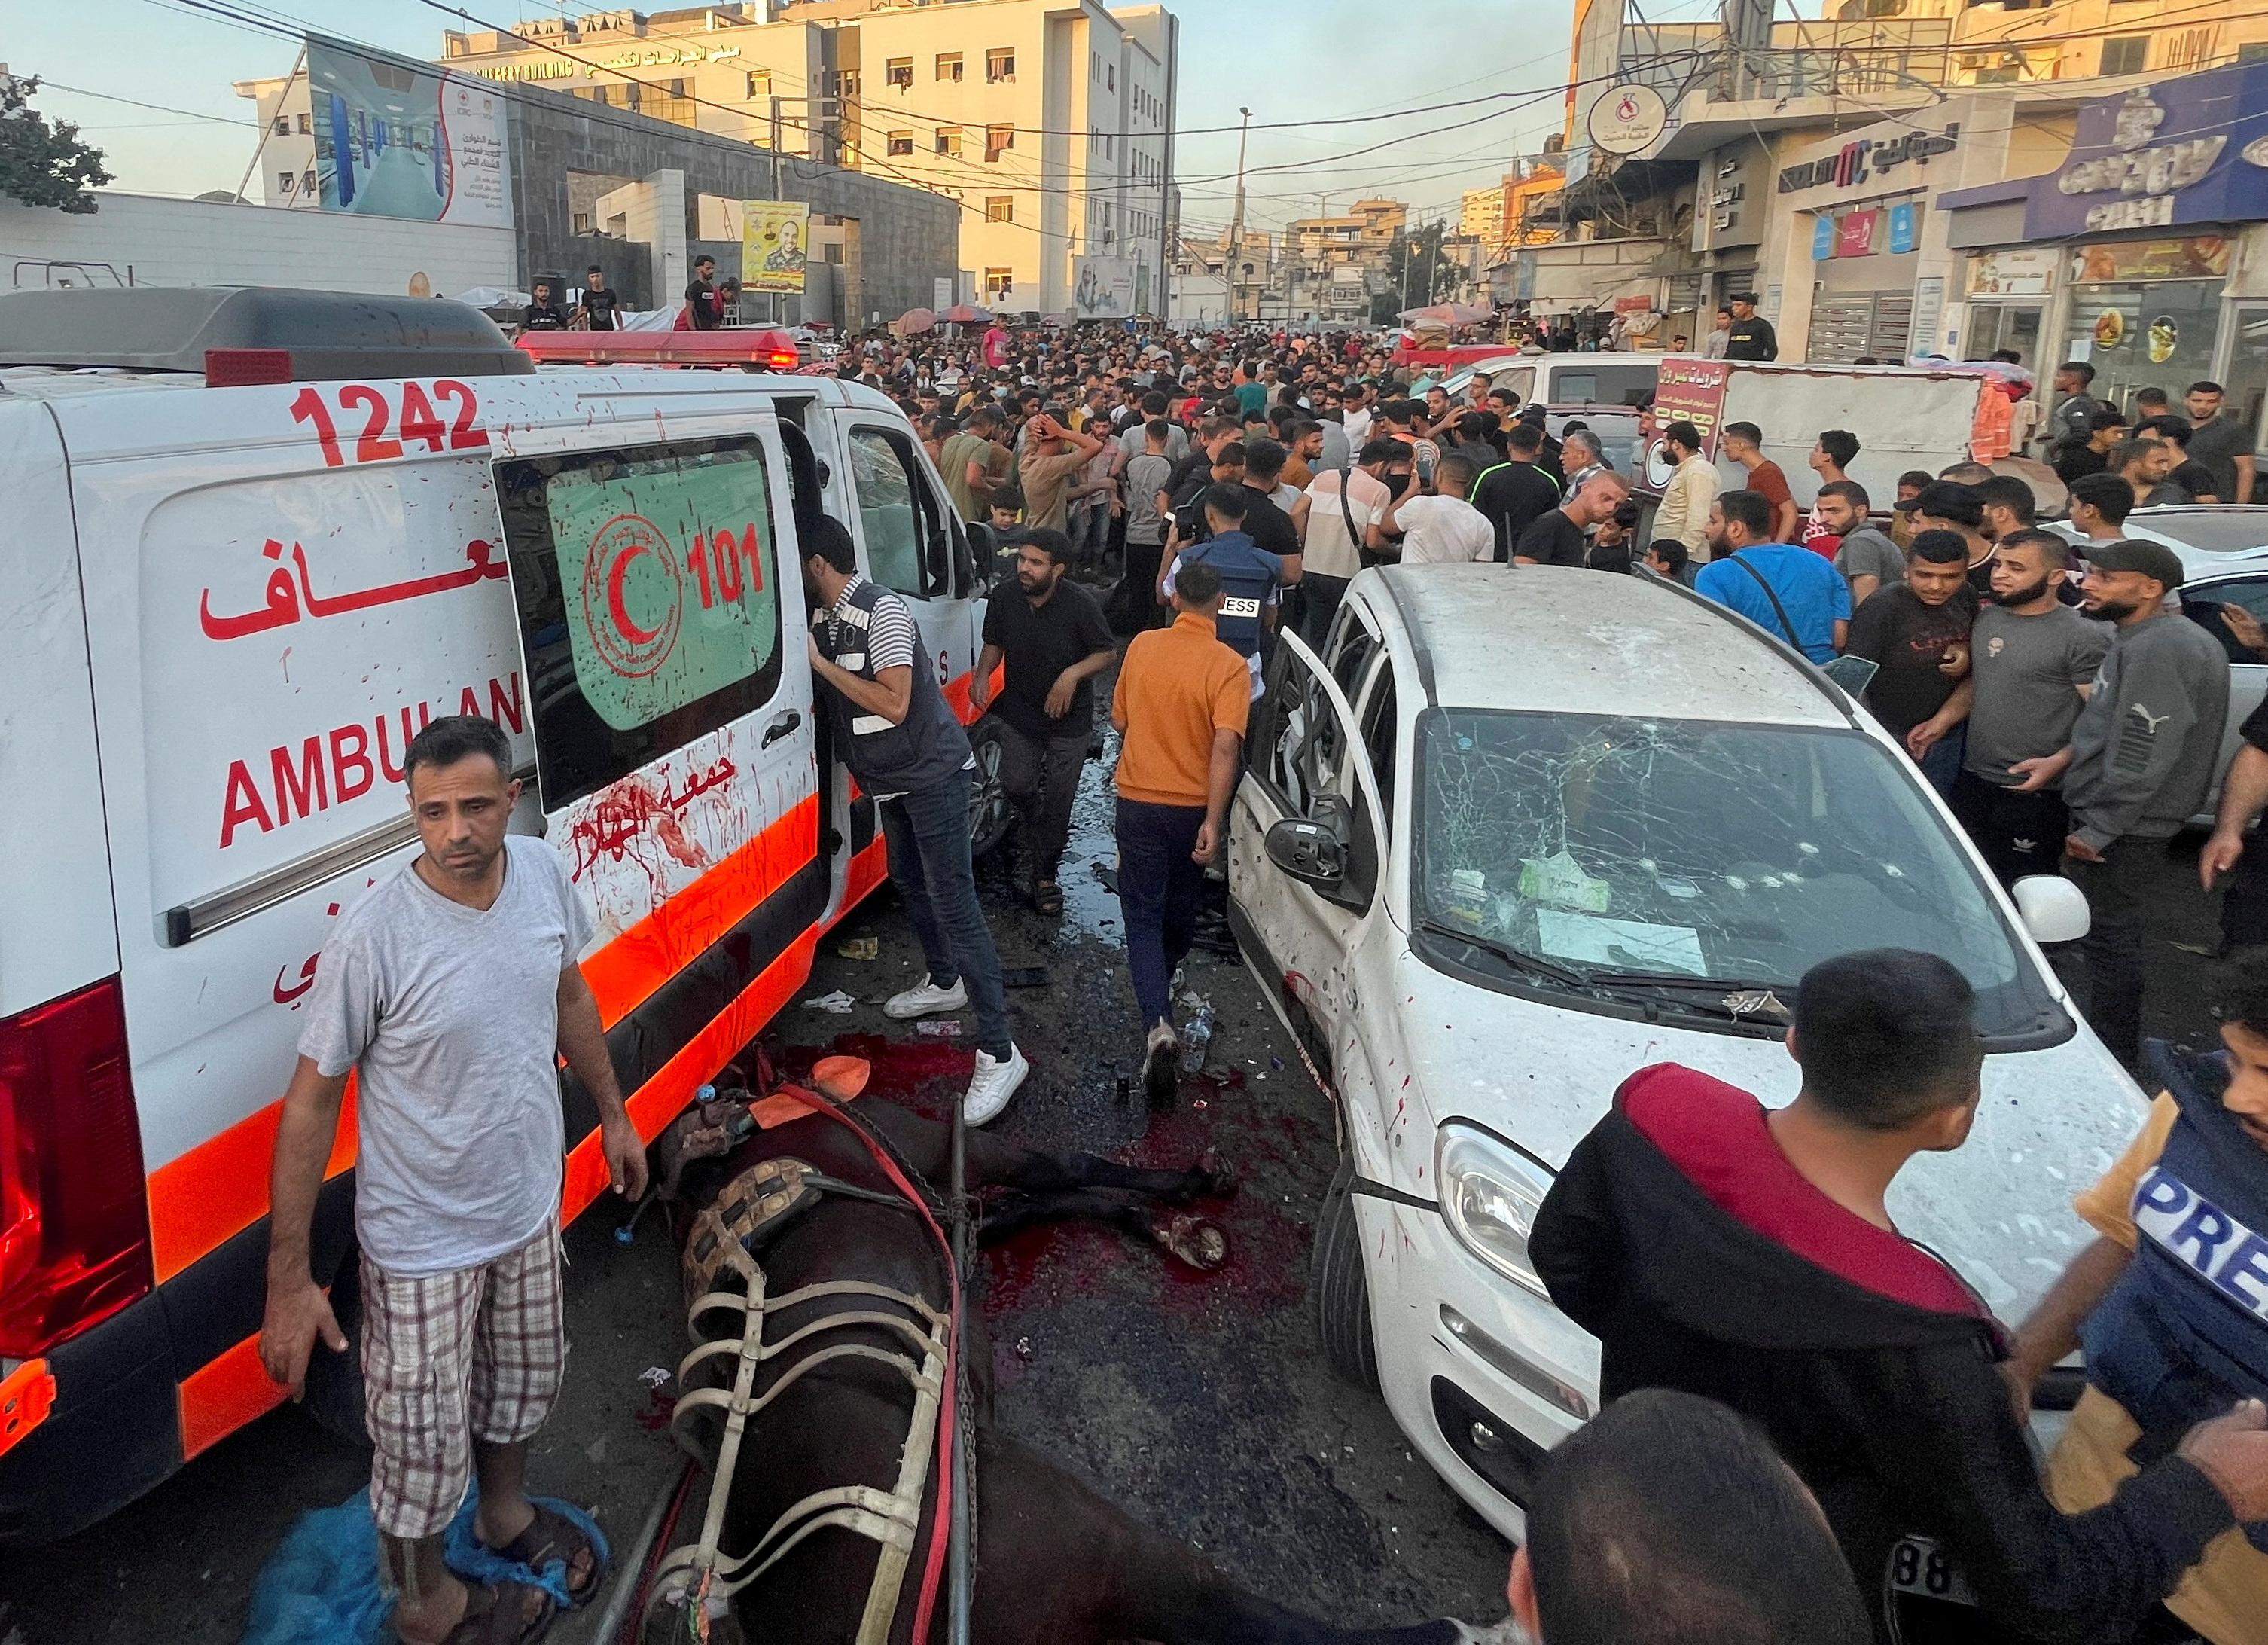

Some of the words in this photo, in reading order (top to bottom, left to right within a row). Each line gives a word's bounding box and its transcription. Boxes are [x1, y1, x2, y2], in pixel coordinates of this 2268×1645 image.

[523, 60, 574, 81] BUILDING
[642, 46, 706, 67] الجراحات
[706, 43, 741, 64] مبنى
[289, 379, 490, 467] 1242
[200, 538, 510, 641] عاف
[687, 523, 764, 609] 101
[1226, 600, 1255, 613] ESS
[658, 756, 736, 822] جمعية
[2133, 1167, 2268, 1310] PRE
